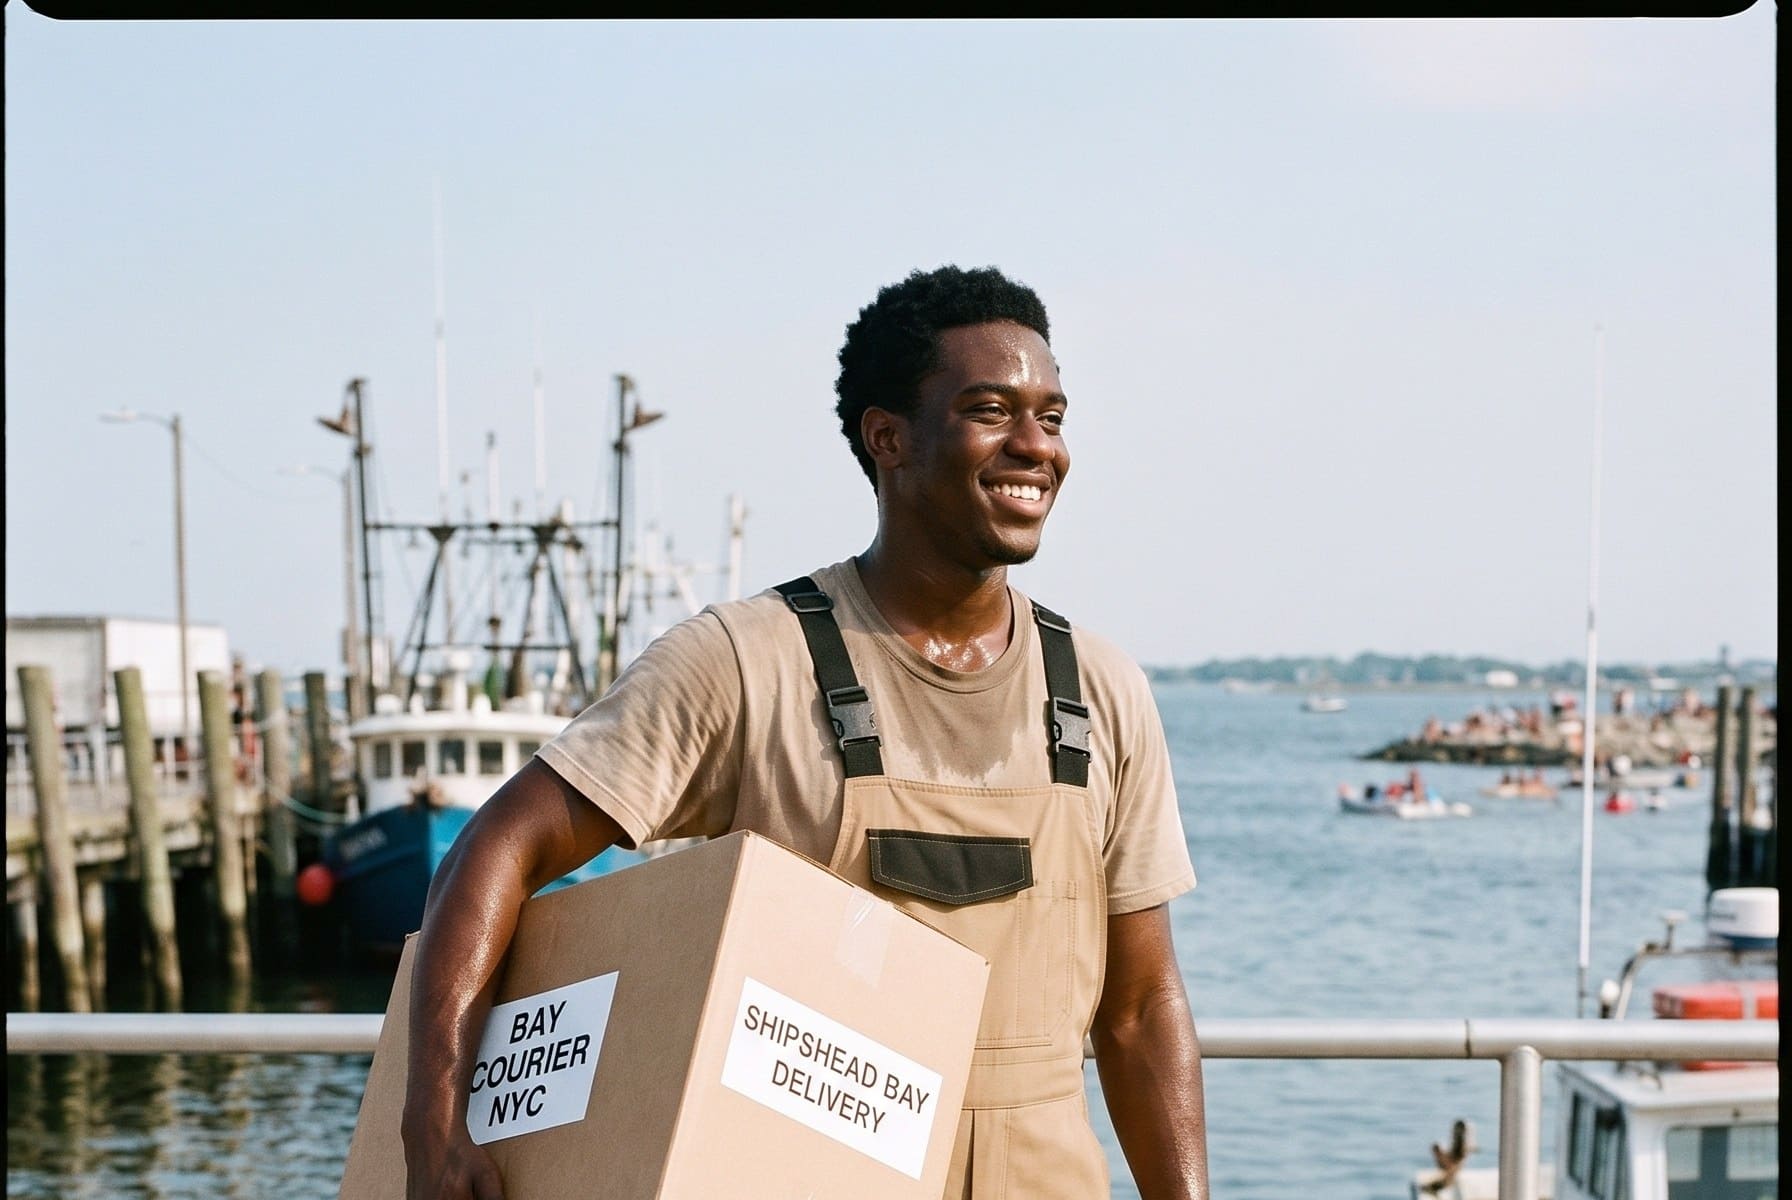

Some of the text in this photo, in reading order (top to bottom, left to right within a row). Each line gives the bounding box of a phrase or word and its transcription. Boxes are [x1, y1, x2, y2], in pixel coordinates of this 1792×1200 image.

[509, 1000, 568, 1044] BAY
[470, 1034, 590, 1094] COURIER
[744, 1005, 930, 1114] SHIPSHEAD BAY
[488, 1085, 547, 1127] NYC
[772, 1060, 886, 1133] DELIVERY
